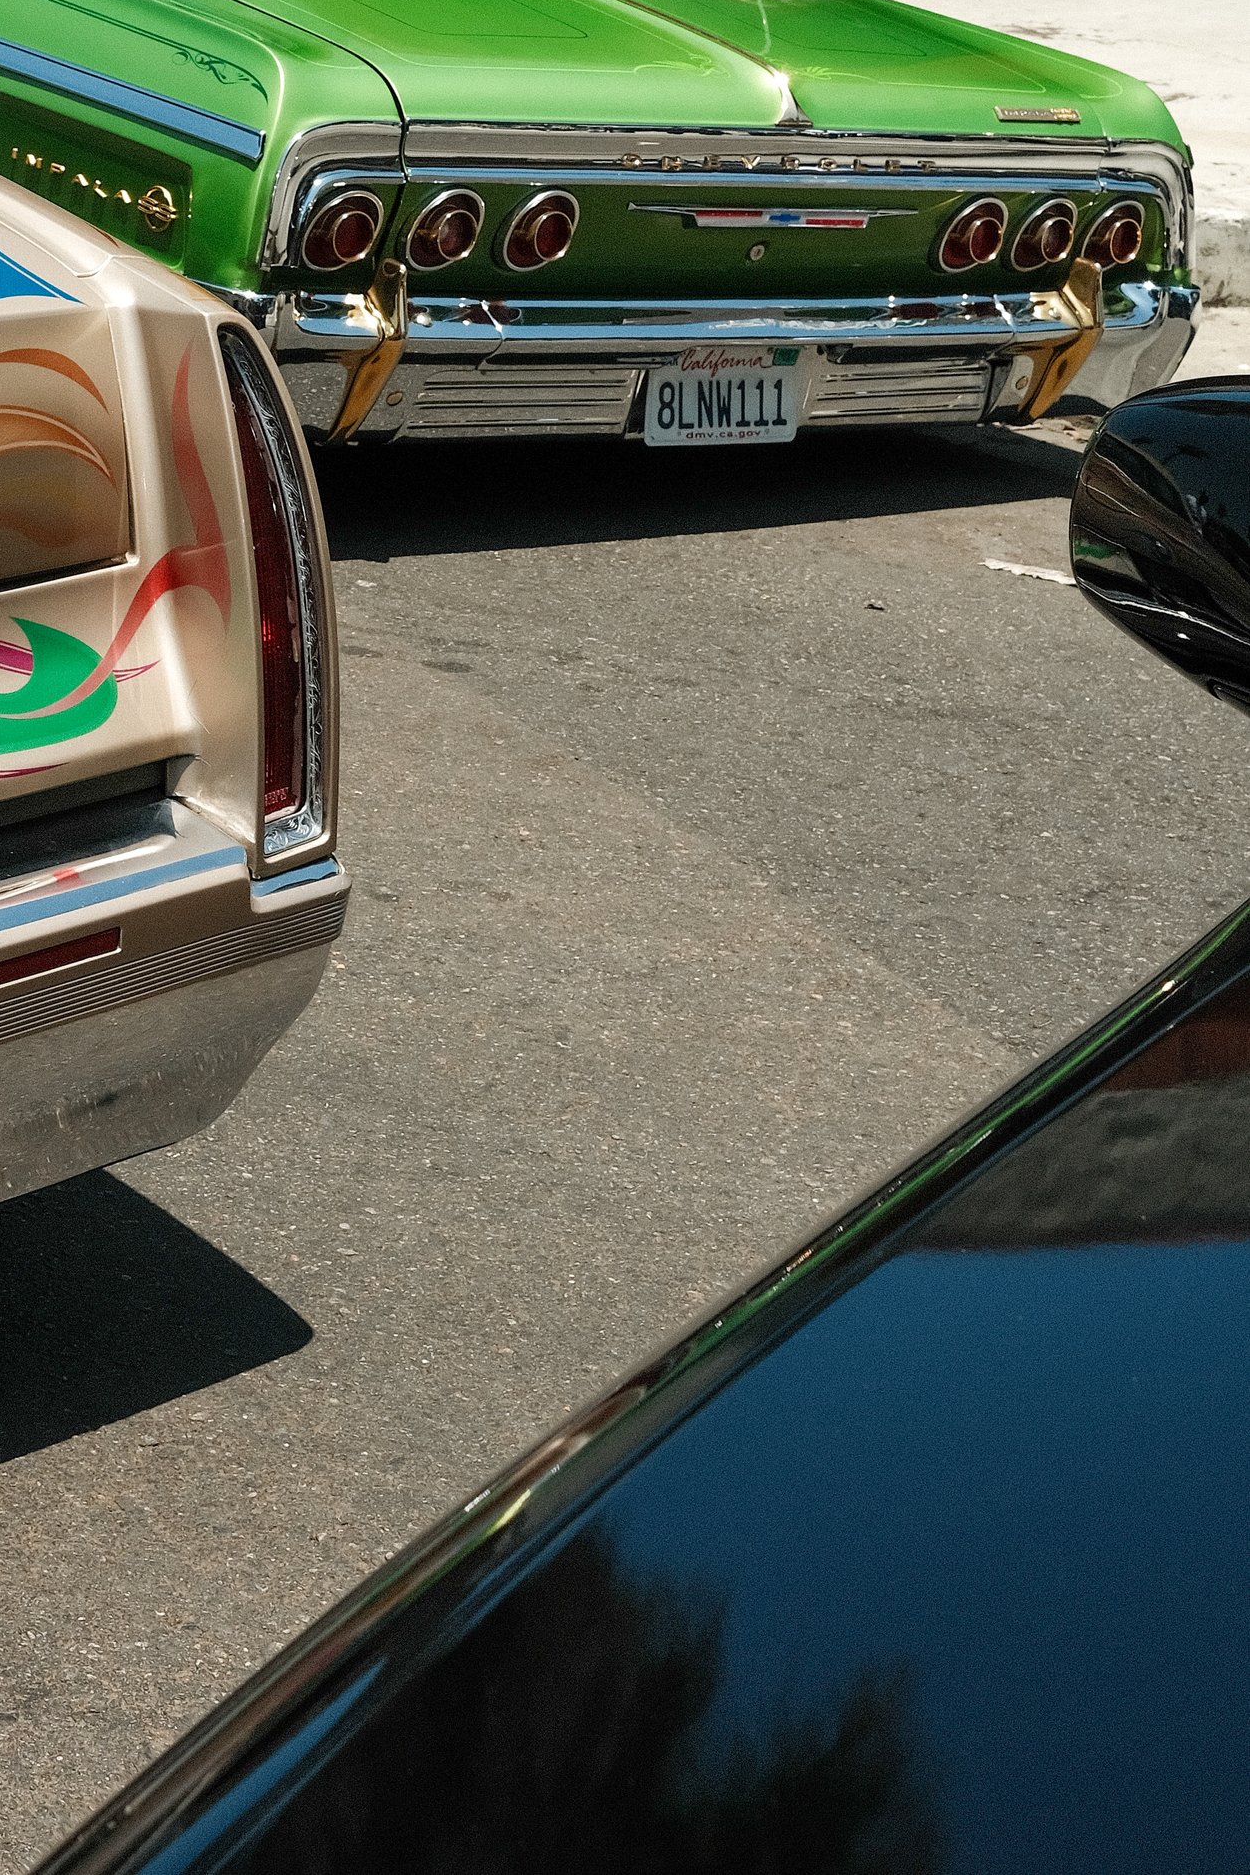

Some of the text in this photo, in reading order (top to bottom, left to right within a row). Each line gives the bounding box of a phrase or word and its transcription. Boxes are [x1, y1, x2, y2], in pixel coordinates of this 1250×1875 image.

[11, 147, 132, 204] IMPALA
[621, 152, 937, 172] CHEVROLET
[681, 346, 773, 377] California
[657, 378, 788, 429] 8LNW111
[685, 428, 762, 440] dmv.ca.gov
